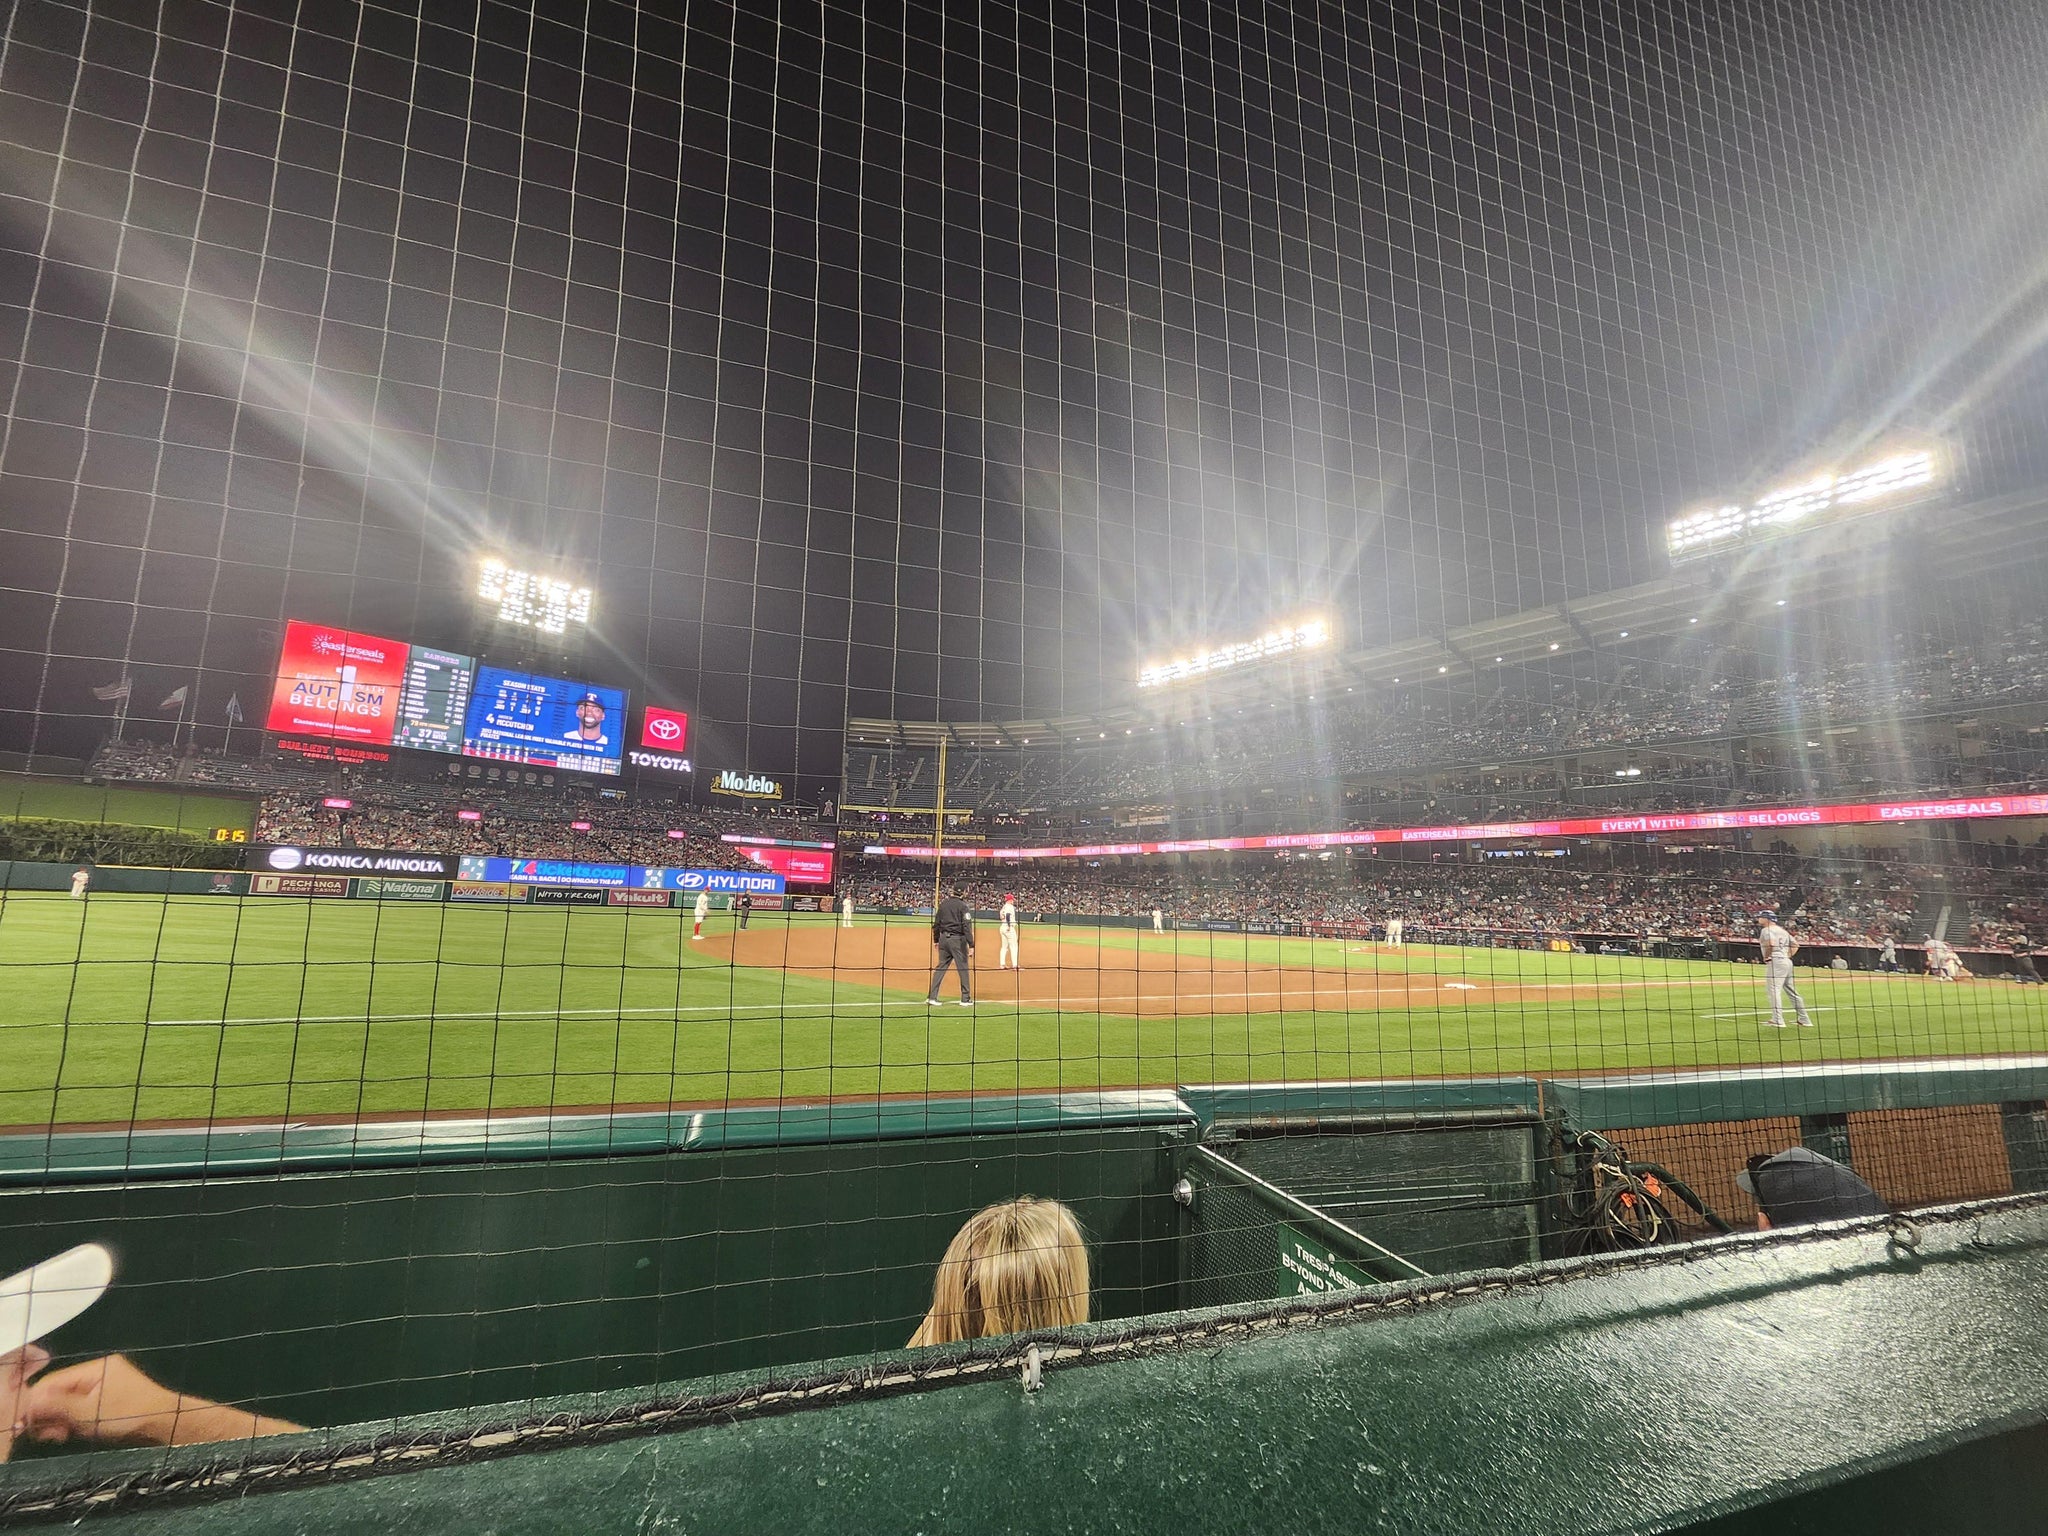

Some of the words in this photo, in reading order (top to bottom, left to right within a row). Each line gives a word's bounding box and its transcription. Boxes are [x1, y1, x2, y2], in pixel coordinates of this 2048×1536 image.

[321, 641, 384, 659] easterseals
[289, 693, 381, 717] BELONGS
[485, 713, 494, 724] 4
[629, 752, 691, 772] TOYOTA
[721, 770, 775, 794] Modelo
[1880, 801, 2003, 818] EASTERSEALS
[1650, 818, 1686, 829] WITH
[1749, 811, 1821, 824] BELONGS
[1402, 829, 1458, 840] EASTERSEALS
[305, 853, 372, 870] KONICA
[374, 857, 444, 873] MINOLTA
[511, 859, 626, 878] 714tickets.com
[282, 880, 342, 889] PECHANGA
[382, 882, 437, 894] National
[561, 877, 599, 885] DOWNLOAD
[708, 875, 776, 891] HYUNDAI
[456, 886, 501, 897] Surfside
[538, 891, 563, 899] NITTO
[613, 892, 666, 903] Yakult
[750, 898, 781, 907] tateFarm
[1282, 1252, 1324, 1290] BEYOND
